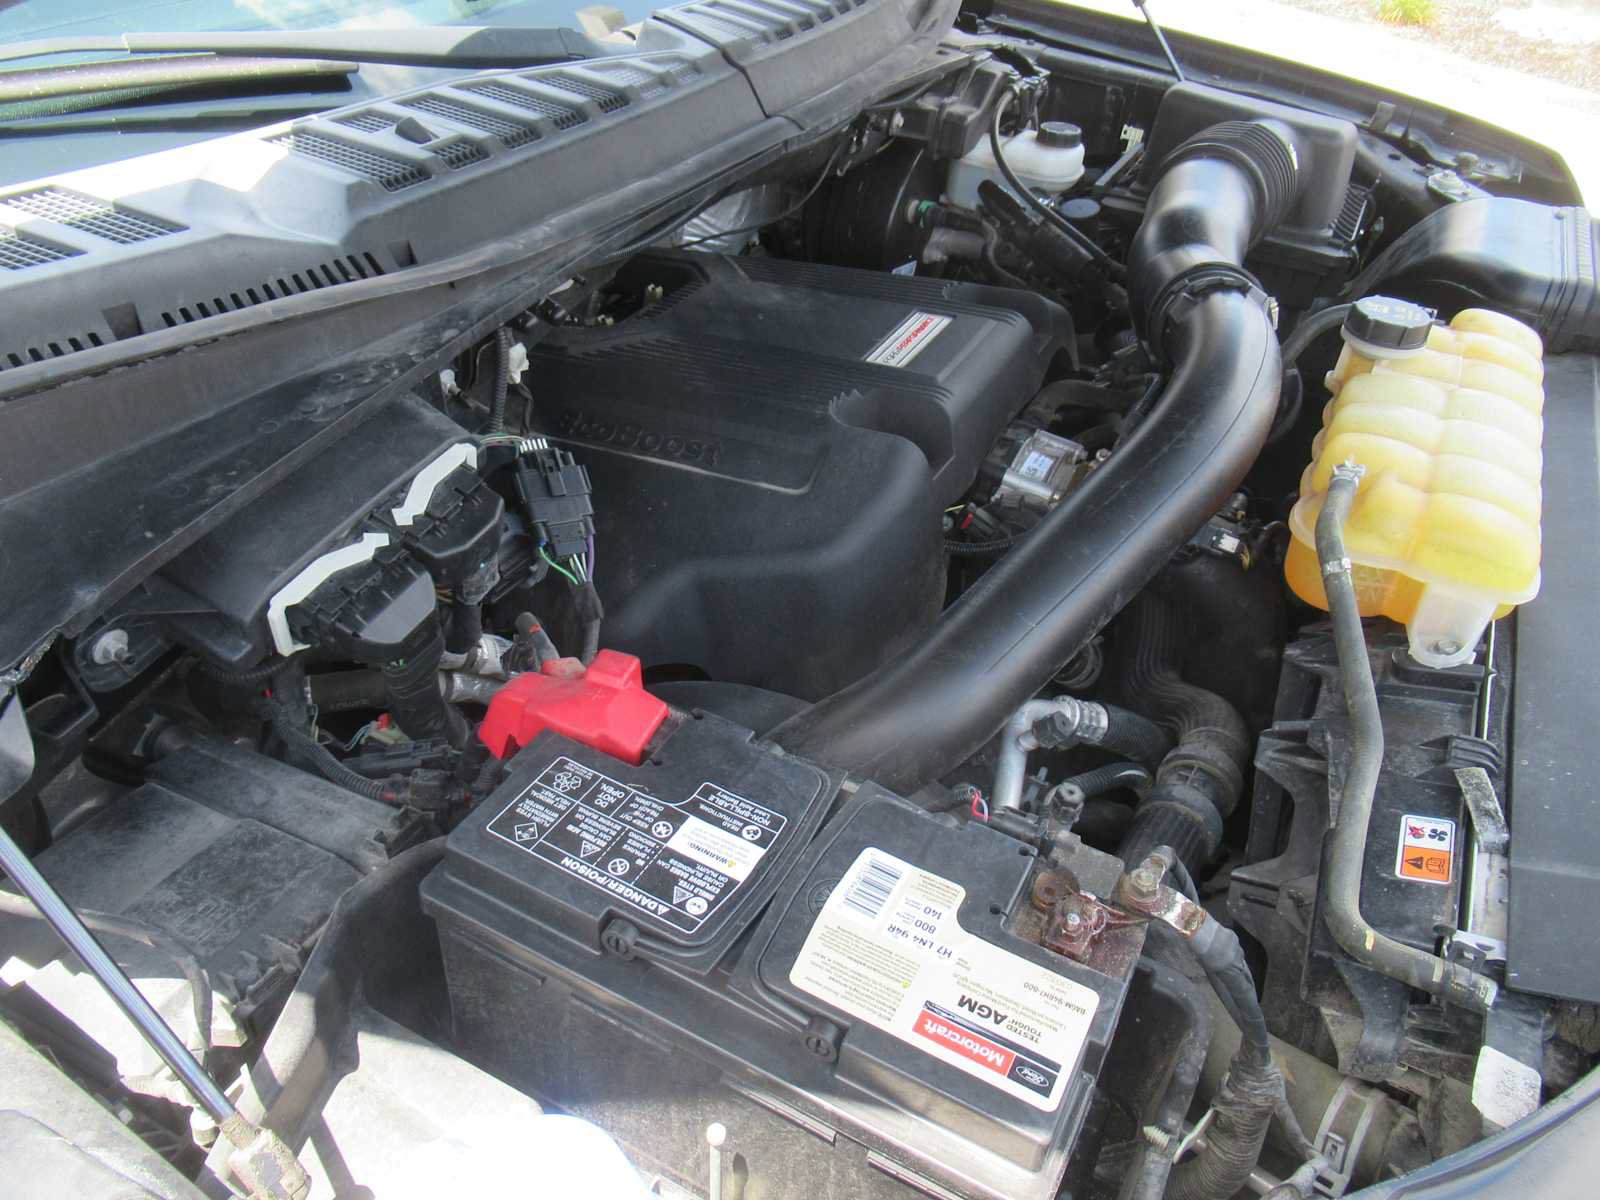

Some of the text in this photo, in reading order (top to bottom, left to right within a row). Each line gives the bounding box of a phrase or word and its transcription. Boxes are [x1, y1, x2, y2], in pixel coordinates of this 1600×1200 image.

[539, 788, 572, 805] HELP FAST.
[596, 790, 616, 803] NOT
[598, 782, 626, 798] OPEN.
[592, 797, 609, 808] DO
[637, 804, 660, 817] REACH
[706, 793, 771, 826] NON-SPILLABLE
[714, 790, 771, 819] Lead Acid Battery
[514, 807, 551, 827] FLUSH EYES
[543, 808, 559, 818] WITH
[618, 812, 650, 828] KEEP OUT
[631, 810, 654, 823] OF THE
[573, 812, 617, 836] BLINDNESS OR
[578, 822, 612, 841] CAN CAUSE
[720, 820, 741, 831] READ
[621, 843, 647, 858] SPARKS
[625, 837, 652, 852] FLAMES
[655, 858, 671, 869] CAN
[667, 857, 725, 887] CAUSE BLINDNESS
[693, 863, 729, 882] OR INJURY.
[560, 856, 659, 910] DANGER/POISON
[922, 905, 943, 920] 140
[912, 917, 937, 935] 800
[885, 922, 953, 958] H7 LN4 94R
[956, 993, 1008, 1027] AGM
[921, 1017, 1006, 1067] Motorcraft
[1005, 1022, 1040, 1044] TESTED
[1019, 1066, 1045, 1086] Ford
